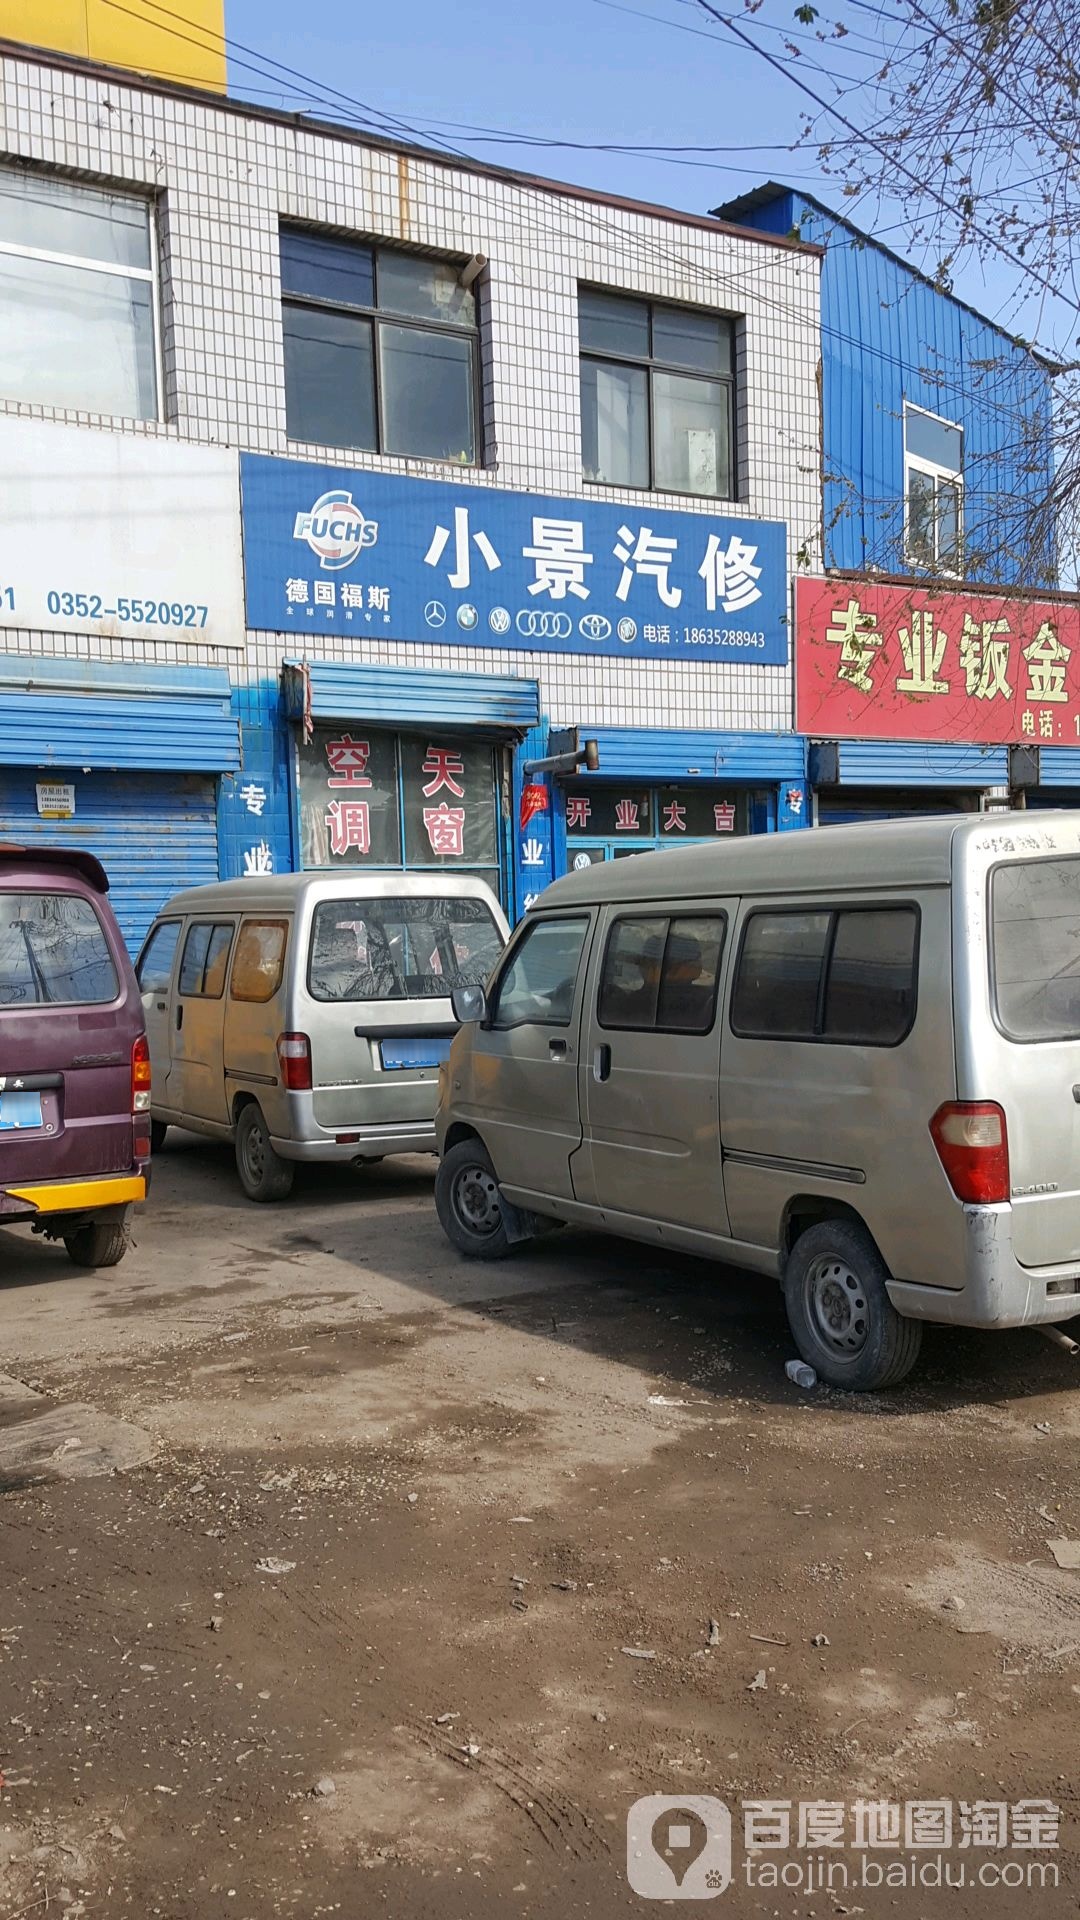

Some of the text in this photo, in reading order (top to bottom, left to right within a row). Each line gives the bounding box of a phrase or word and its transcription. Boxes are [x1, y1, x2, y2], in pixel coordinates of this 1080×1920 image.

[295, 514, 377, 545] FUCHS
[424, 506, 763, 613] 小景汽修
[47, 590, 209, 628] 0352-5520927
[285, 578, 391, 612] 德国福斯
[825, 599, 1072, 703] 专业钣金
[239, 783, 273, 877] 专业
[324, 733, 373, 856] 空调
[422, 746, 465, 856] 天窗
[566, 797, 736, 832] 开业大吉
